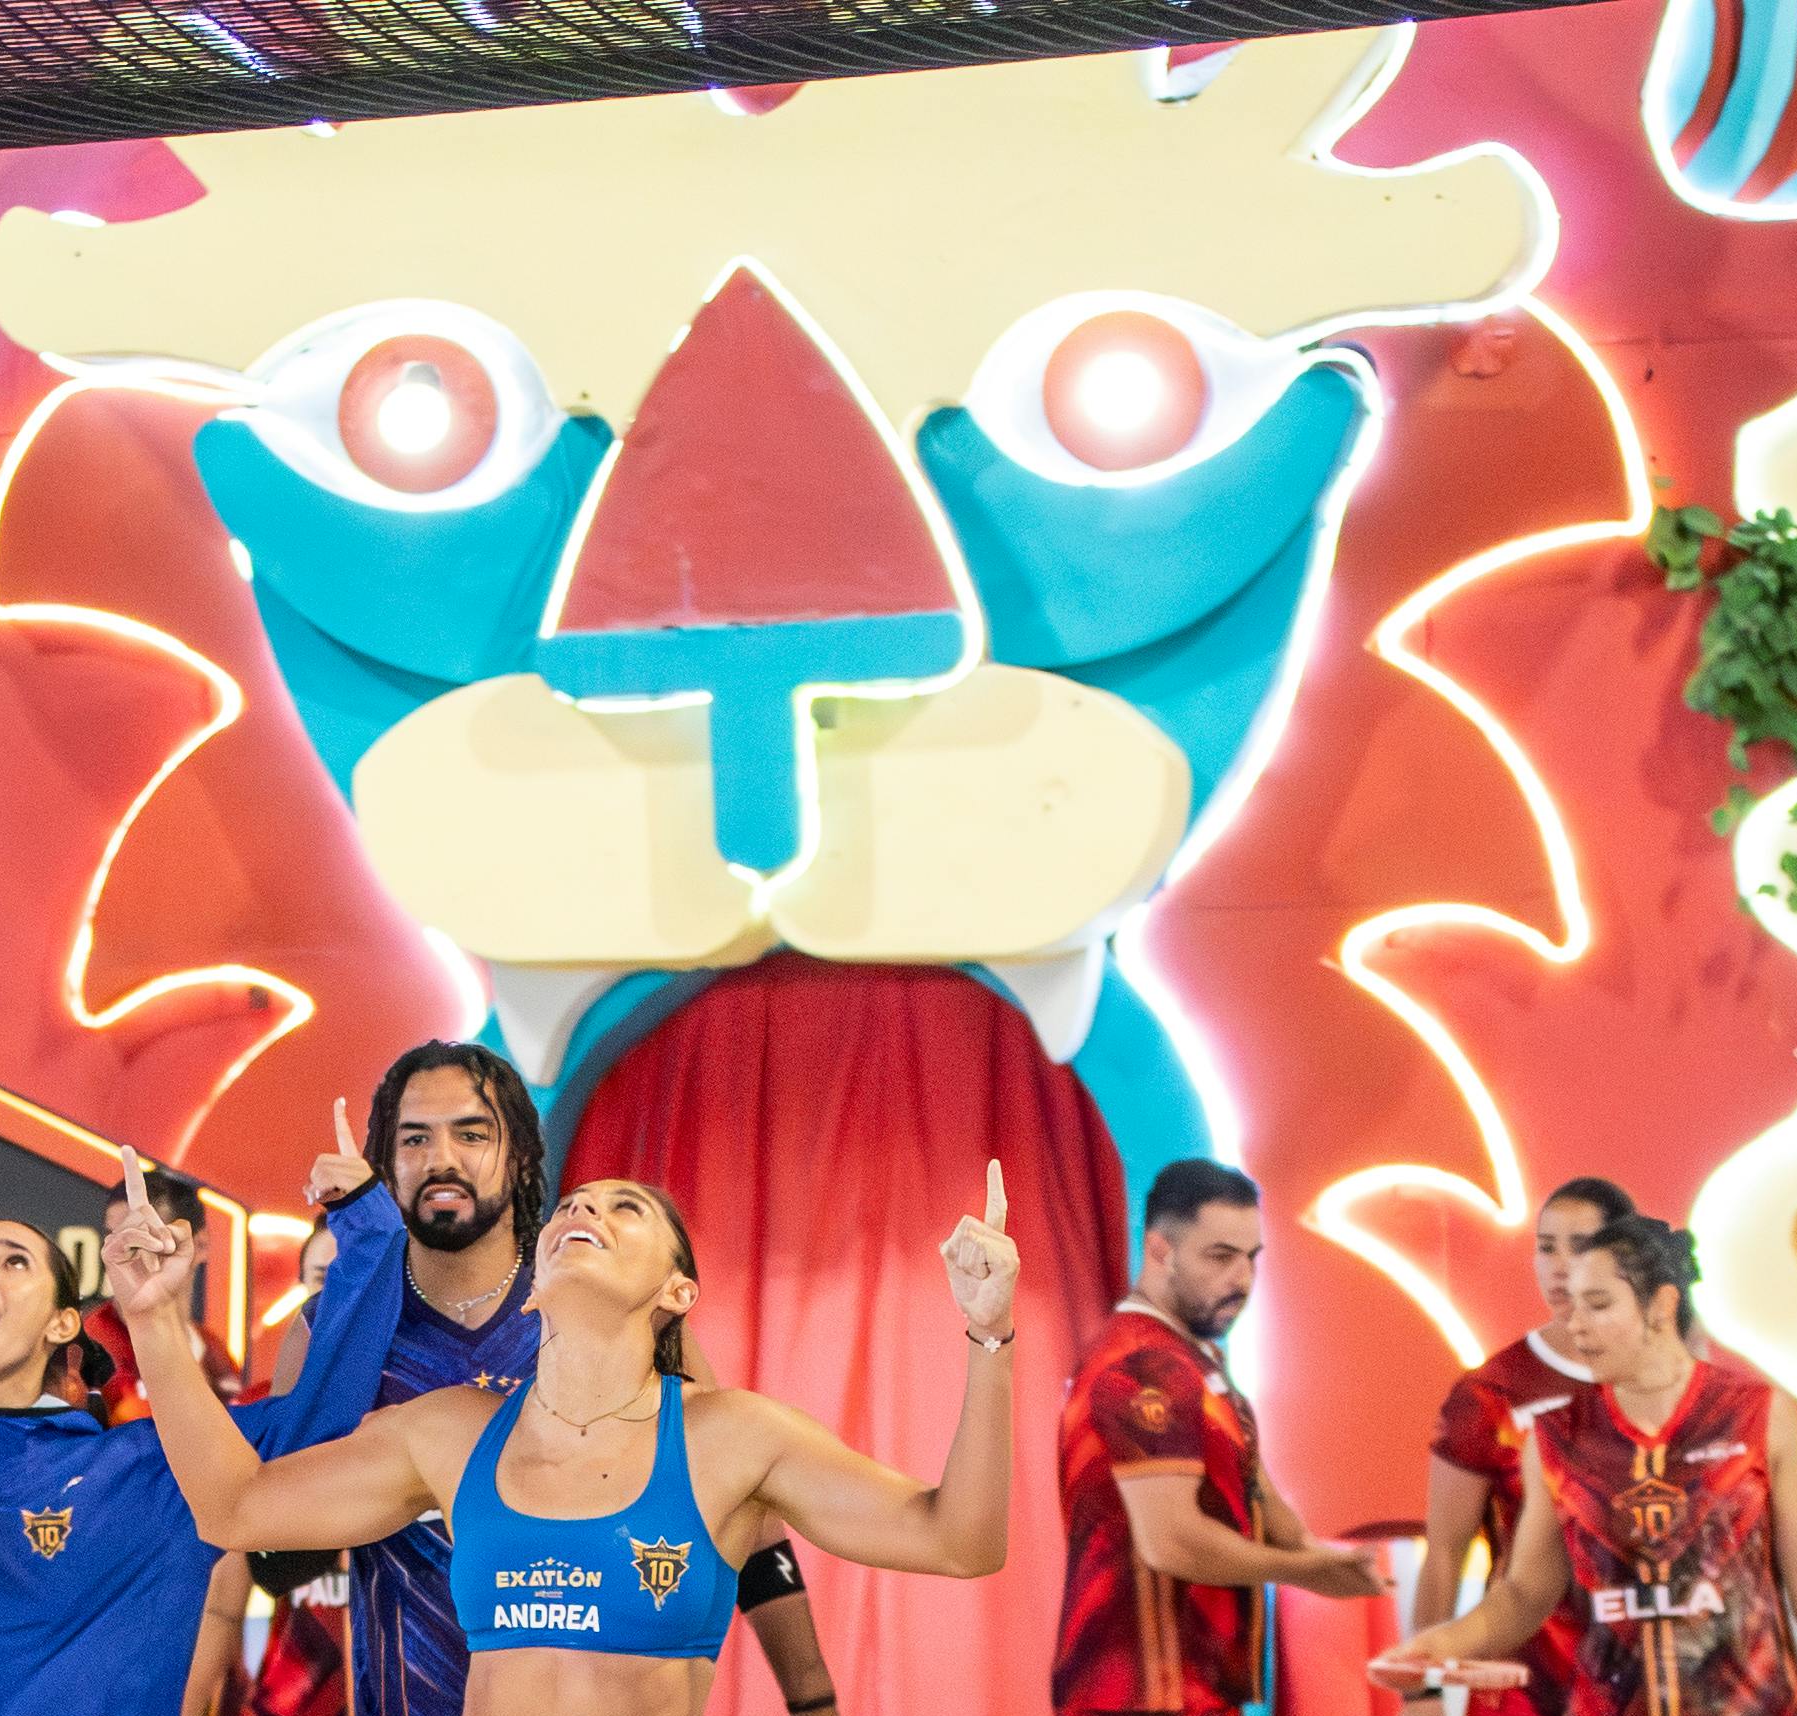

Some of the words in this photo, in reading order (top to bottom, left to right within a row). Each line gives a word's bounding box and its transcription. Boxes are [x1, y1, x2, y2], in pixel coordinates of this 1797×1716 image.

[37, 1526, 60, 1548] 10
[649, 1559, 675, 1588] 10
[493, 1602, 601, 1633] ANDREA
[1592, 1582, 1726, 1624] ELLA
